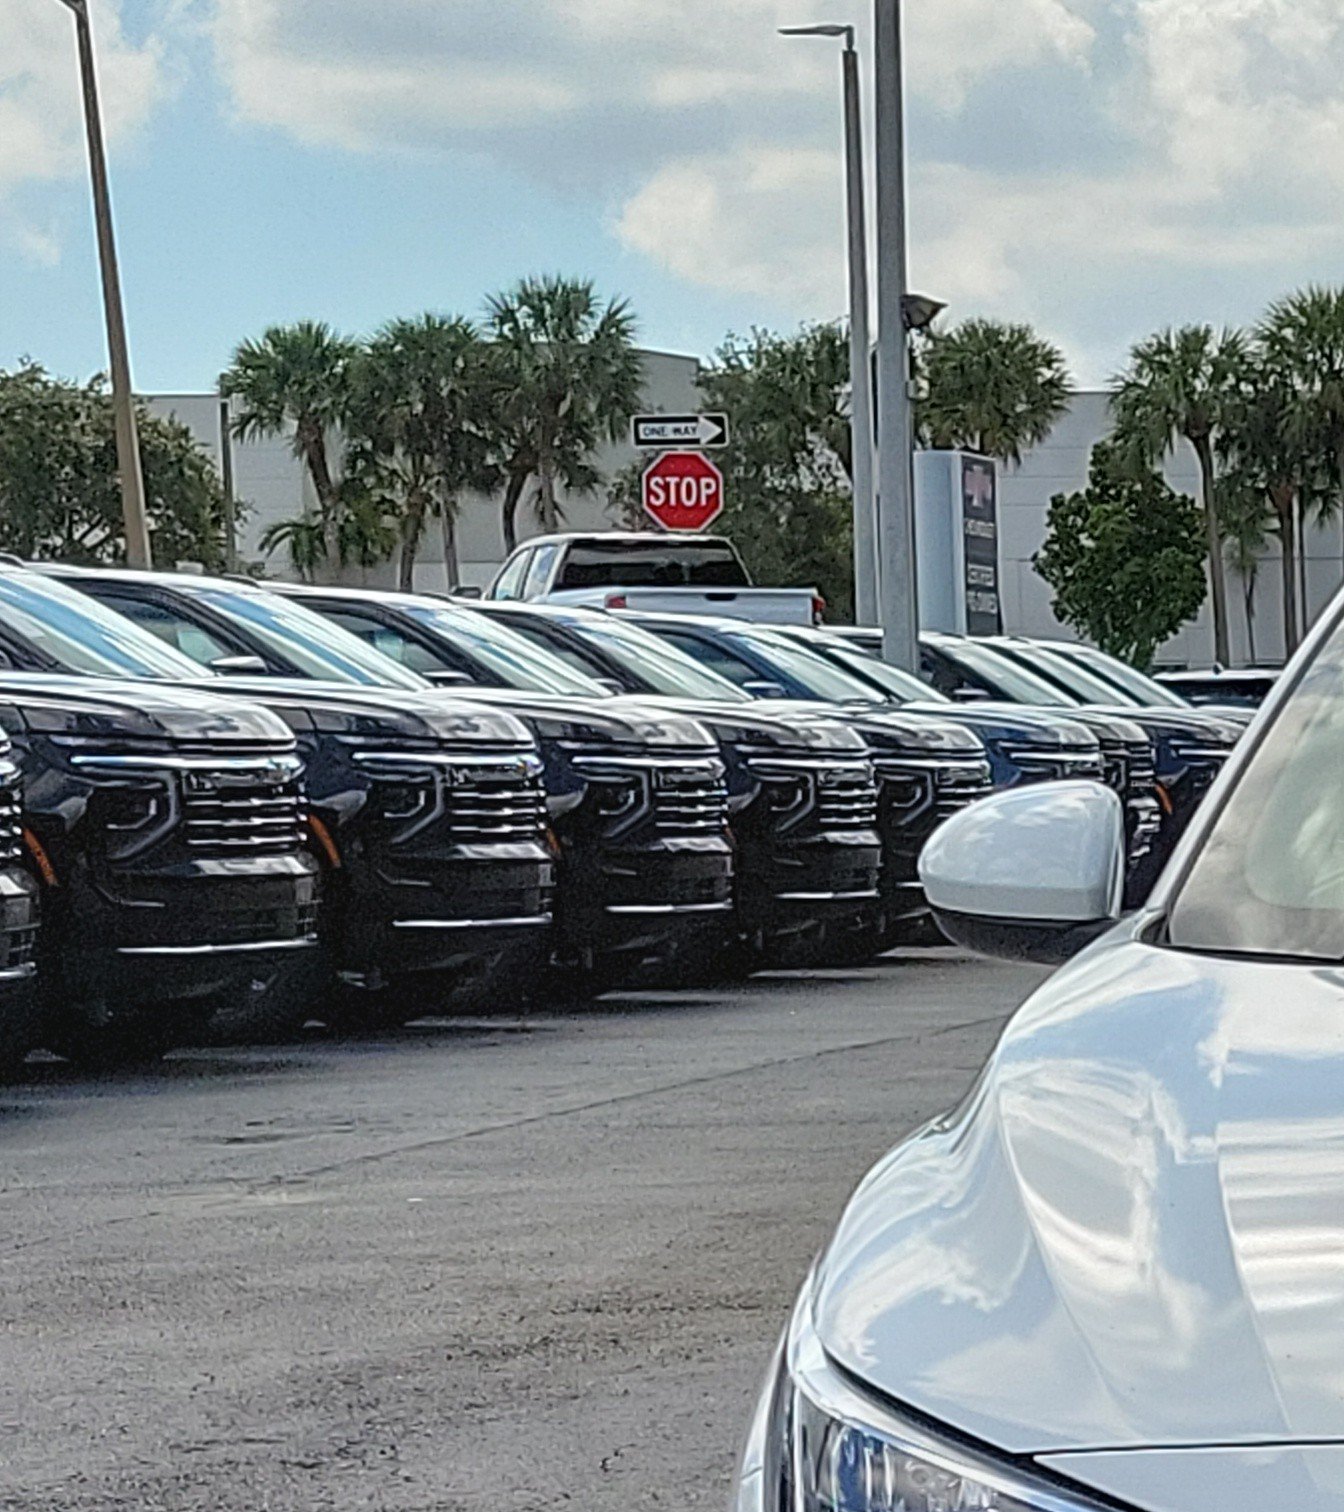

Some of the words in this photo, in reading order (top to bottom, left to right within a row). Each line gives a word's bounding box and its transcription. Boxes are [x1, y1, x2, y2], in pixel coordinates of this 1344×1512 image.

[643, 425, 668, 437] ONE
[672, 425, 697, 436] WAY
[649, 476, 717, 507] STOP
